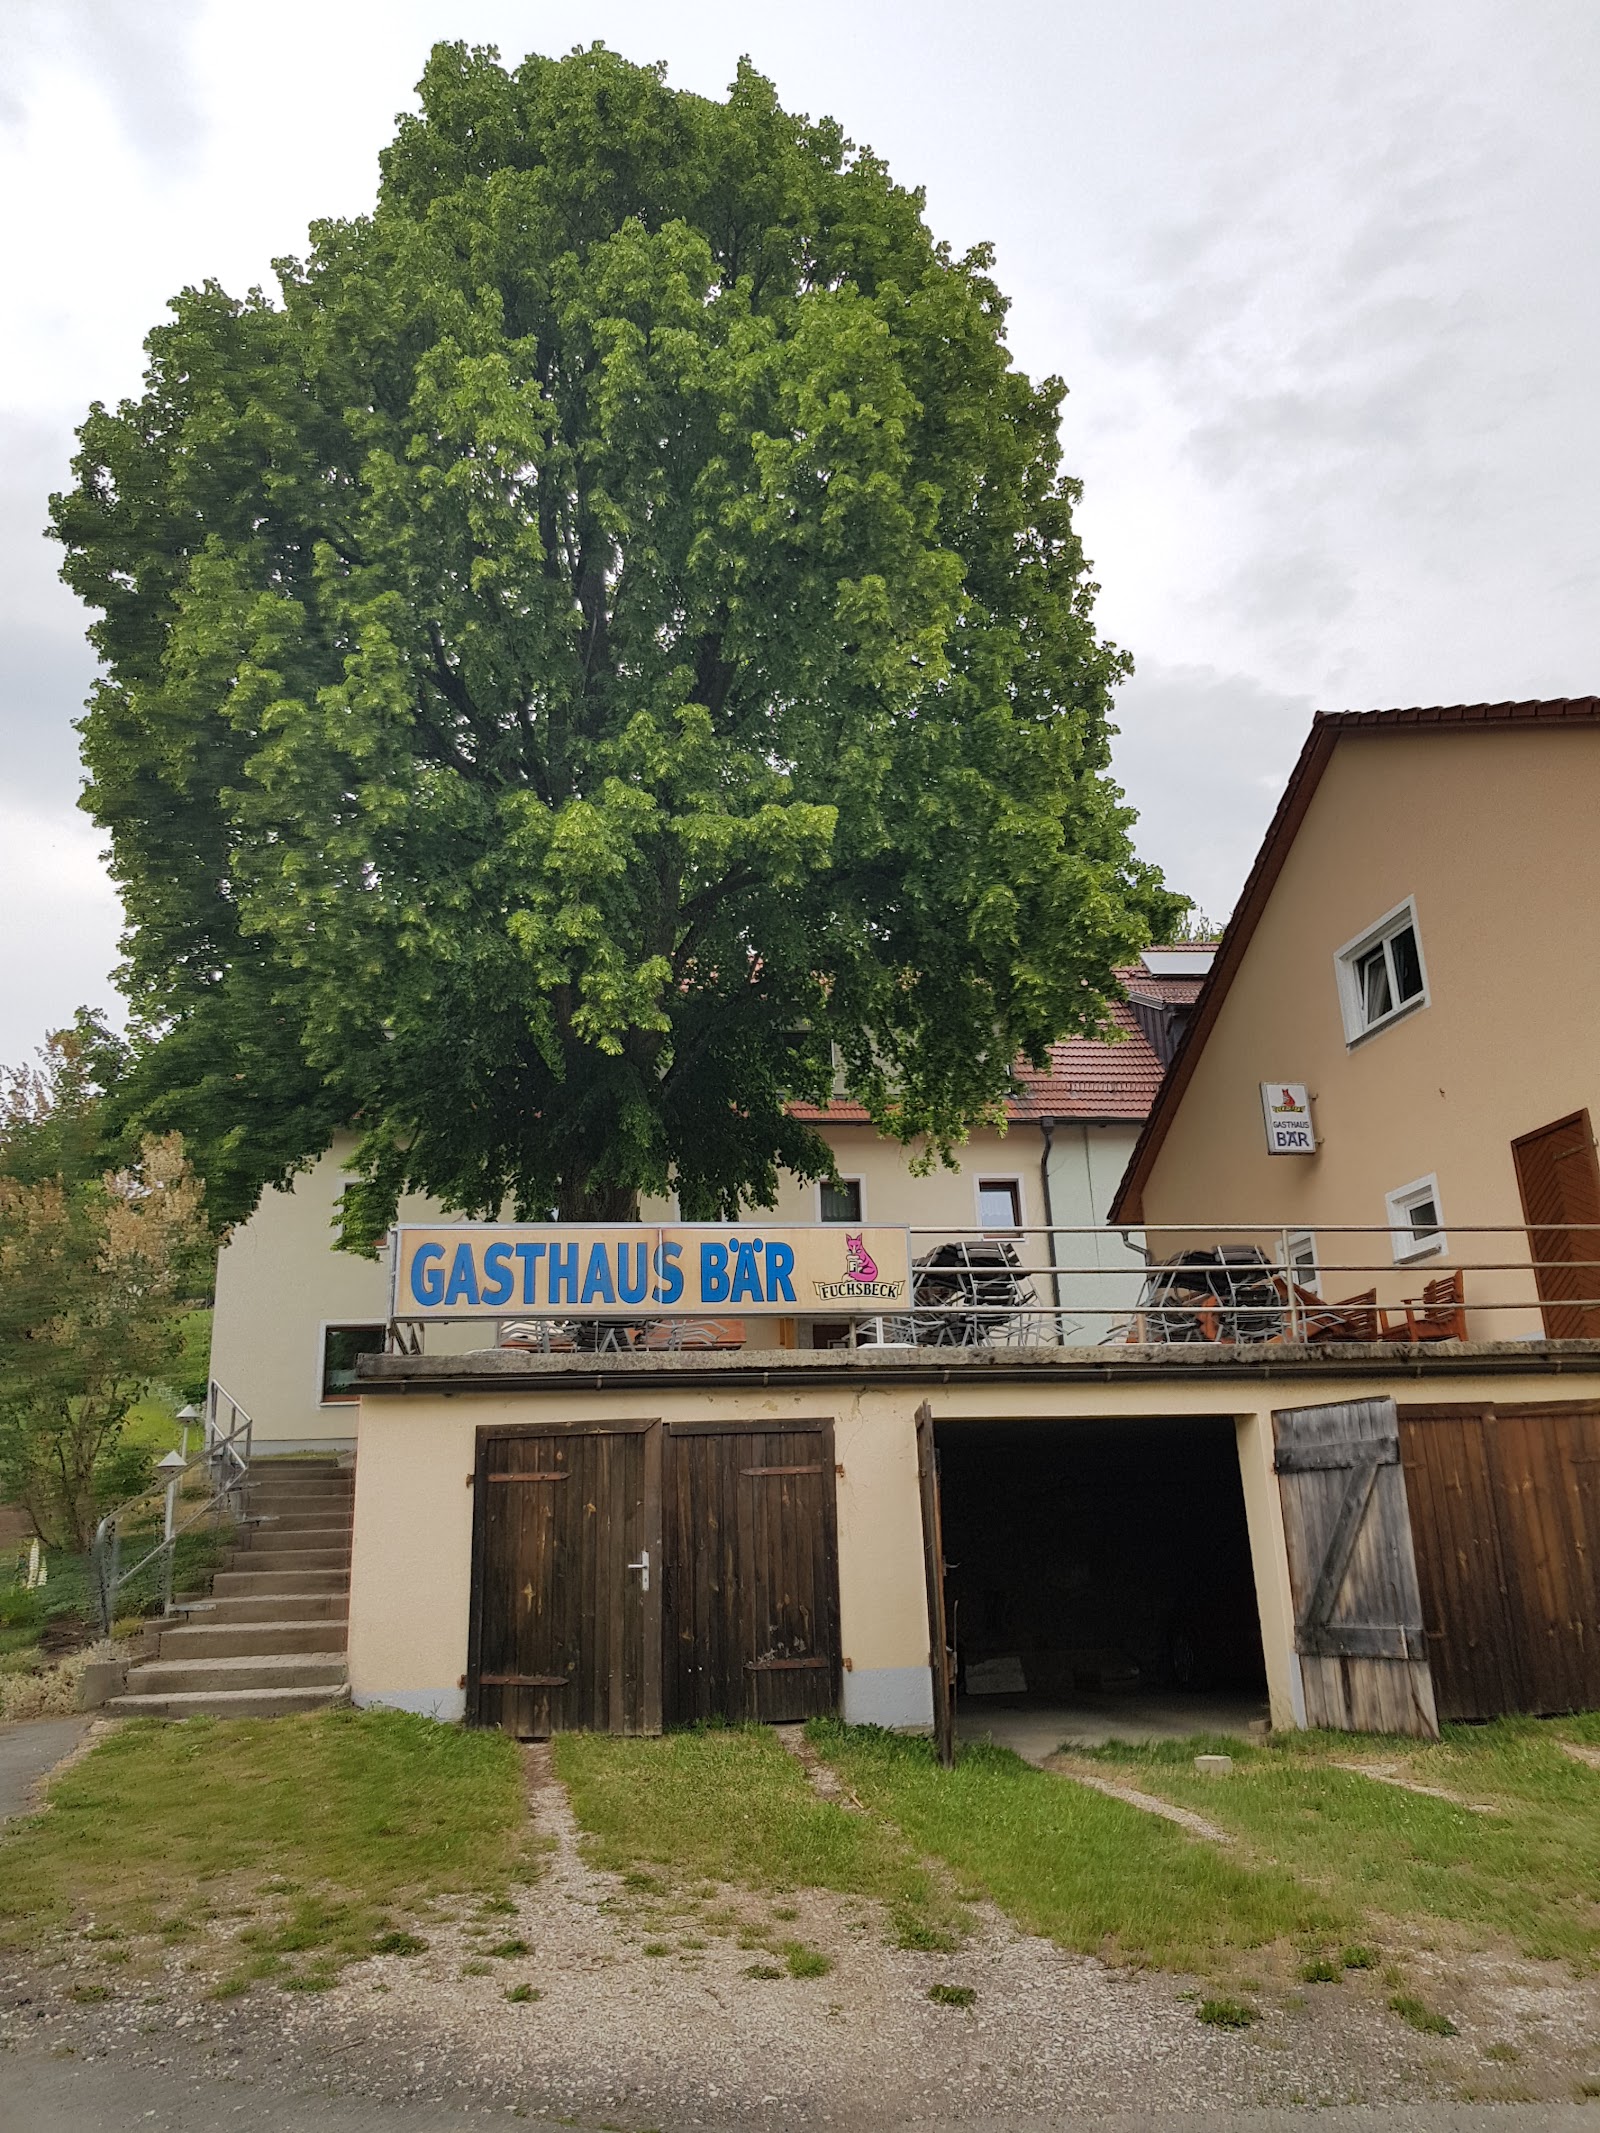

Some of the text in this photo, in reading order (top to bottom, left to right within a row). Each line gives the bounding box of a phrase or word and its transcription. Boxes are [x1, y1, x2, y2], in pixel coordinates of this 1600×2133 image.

[1276, 1131, 1309, 1146] BÄR
[410, 1237, 797, 1306] GASTHAUS BÄR
[821, 1282, 898, 1299] FUCHSBECK
